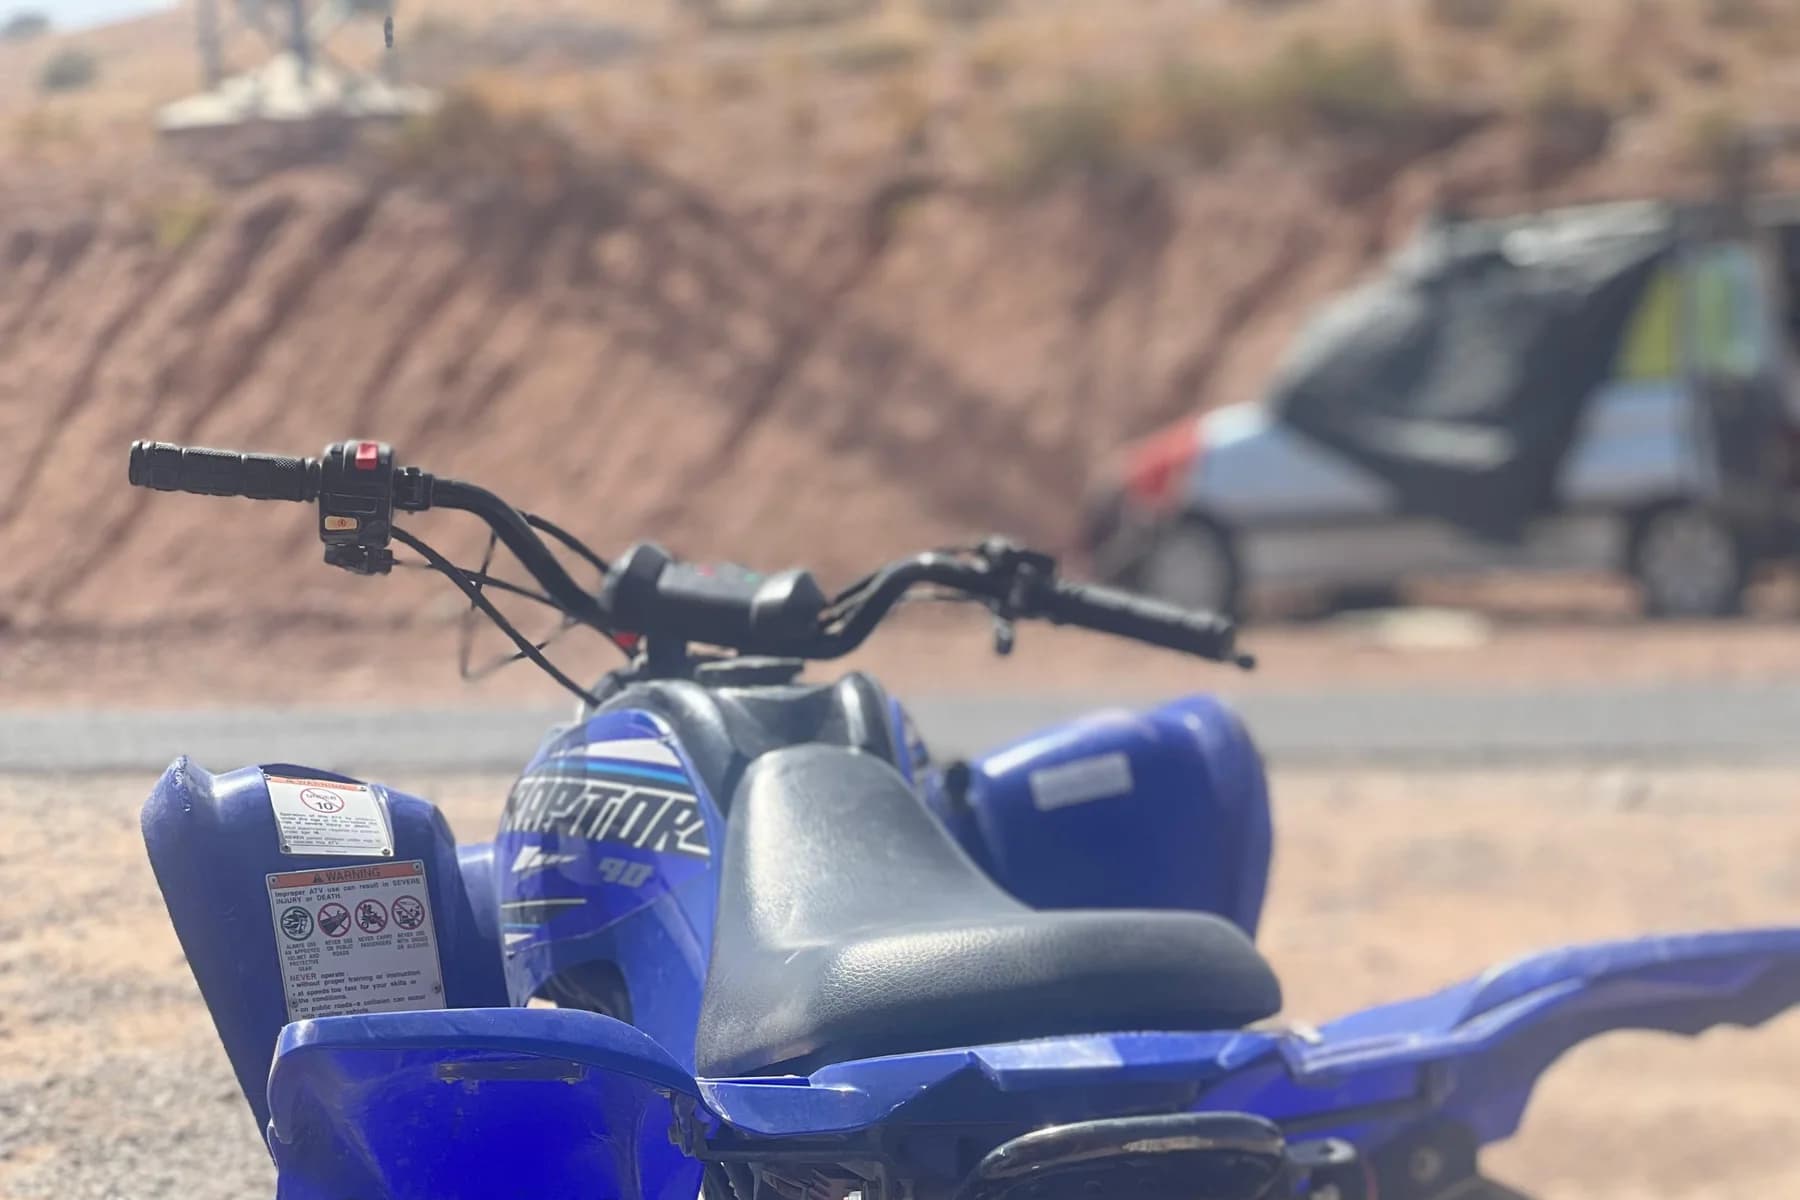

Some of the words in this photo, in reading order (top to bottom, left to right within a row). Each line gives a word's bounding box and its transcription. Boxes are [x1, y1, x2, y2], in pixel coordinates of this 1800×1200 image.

[316, 802, 334, 810] 10
[507, 777, 711, 856] RAPTOR
[326, 868, 381, 882] WARNING
[599, 857, 654, 888] 90
[275, 890, 306, 898] Improper
[309, 887, 323, 895] ATV
[359, 882, 379, 890] result
[392, 878, 421, 887] SEVERE
[276, 896, 302, 905] INJURY
[289, 973, 317, 982] NEVER
[296, 980, 320, 988] without
[324, 978, 345, 987] proper
[348, 974, 373, 983] training
[306, 988, 330, 997] speeds
[372, 983, 388, 991] your
[311, 1004, 331, 1013] public
